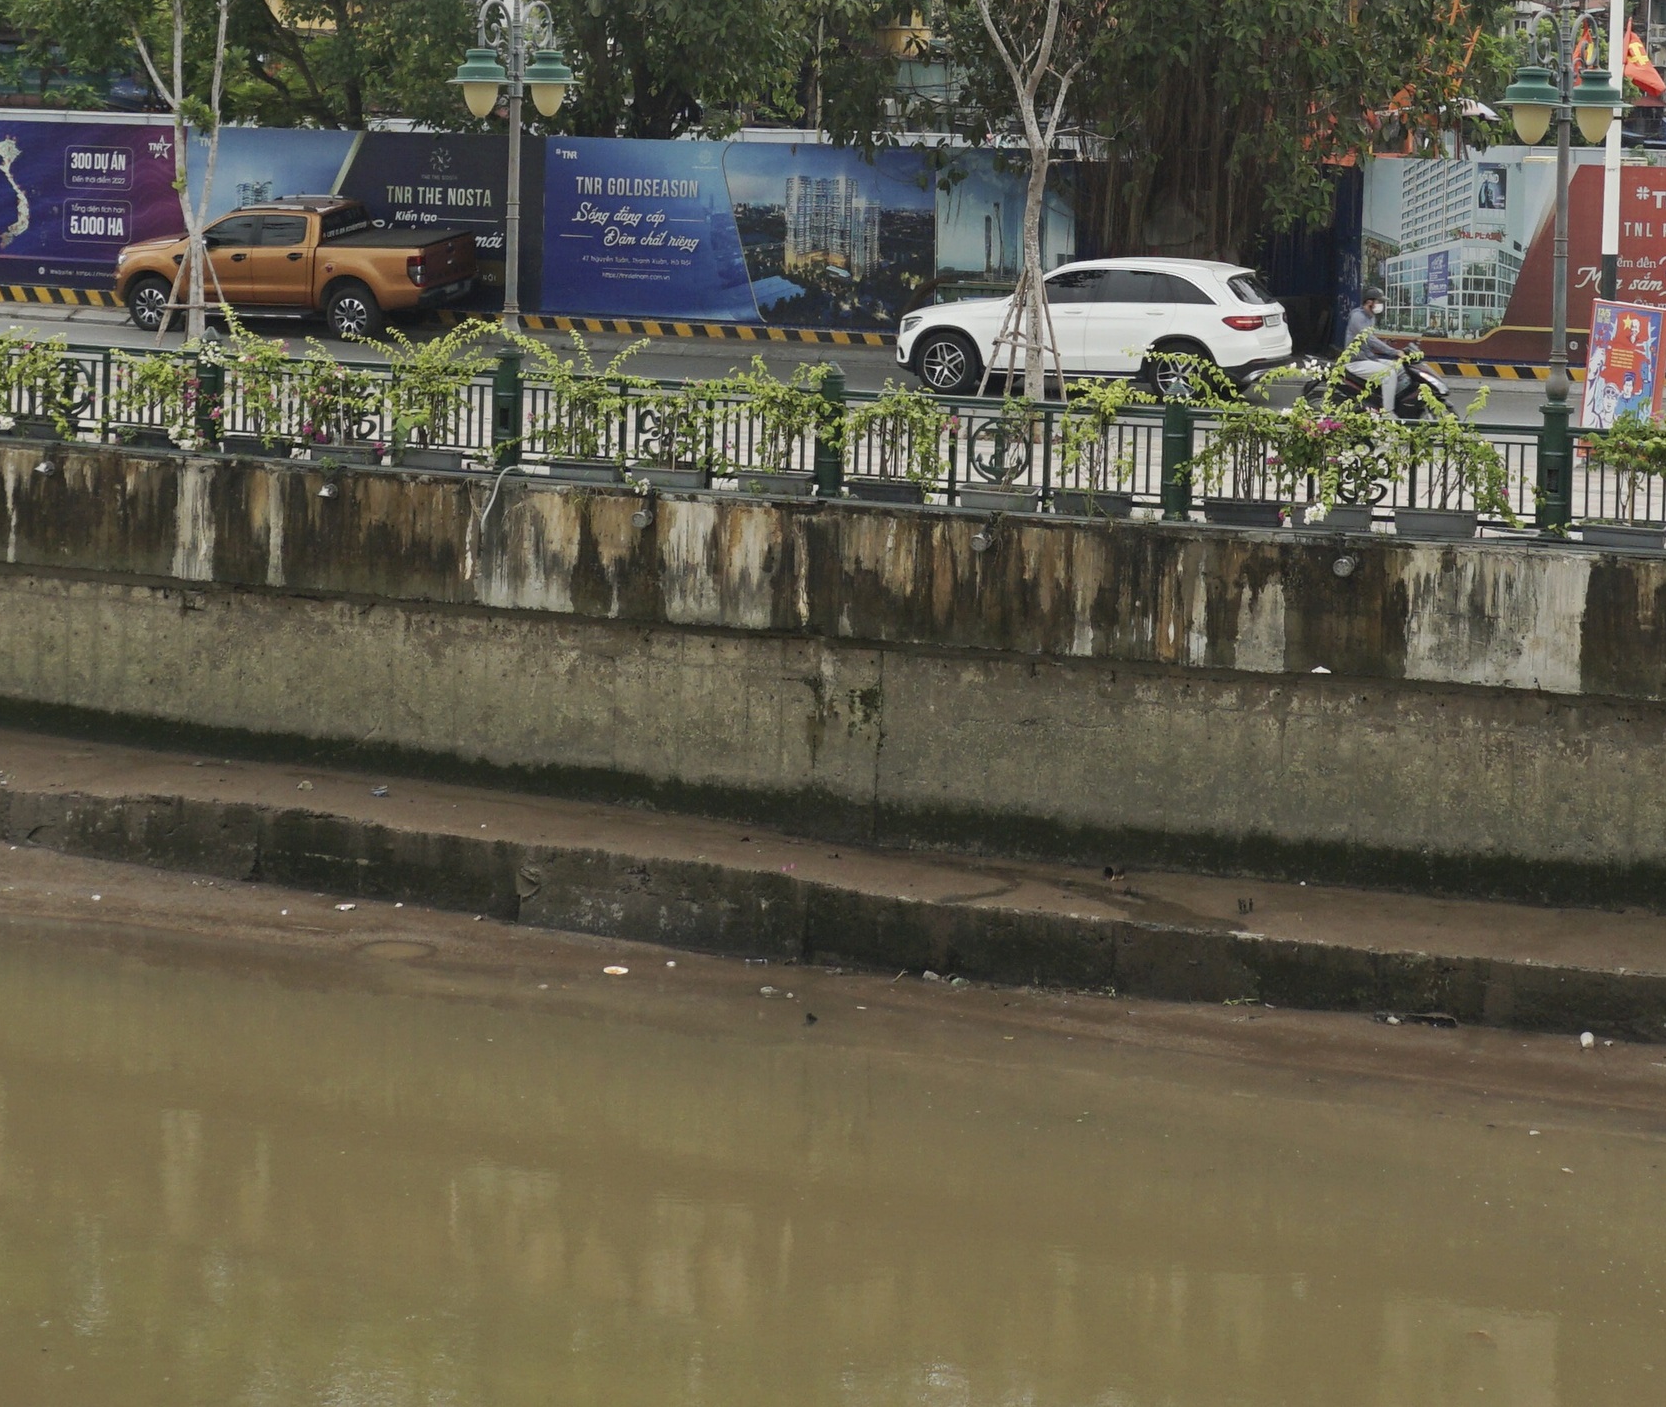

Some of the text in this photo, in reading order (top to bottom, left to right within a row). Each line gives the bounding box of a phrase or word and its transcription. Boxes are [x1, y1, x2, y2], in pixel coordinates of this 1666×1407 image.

[70, 151, 126, 174] 300 DỰ ÁN
[562, 150, 578, 160] TNR
[386, 185, 492, 207] TNR THE NOSTA
[576, 176, 699, 198] TNR GOLDSEASON
[394, 210, 438, 225] Kiến tạo
[571, 201, 610, 226] Sống
[645, 209, 666, 228] cấp
[70, 215, 124, 237] 5.000 HA
[1624, 221, 1654, 237] TNL
[640, 230, 668, 246] chất
[667, 235, 700, 253] riêng
[1636, 255, 1657, 269] đến
